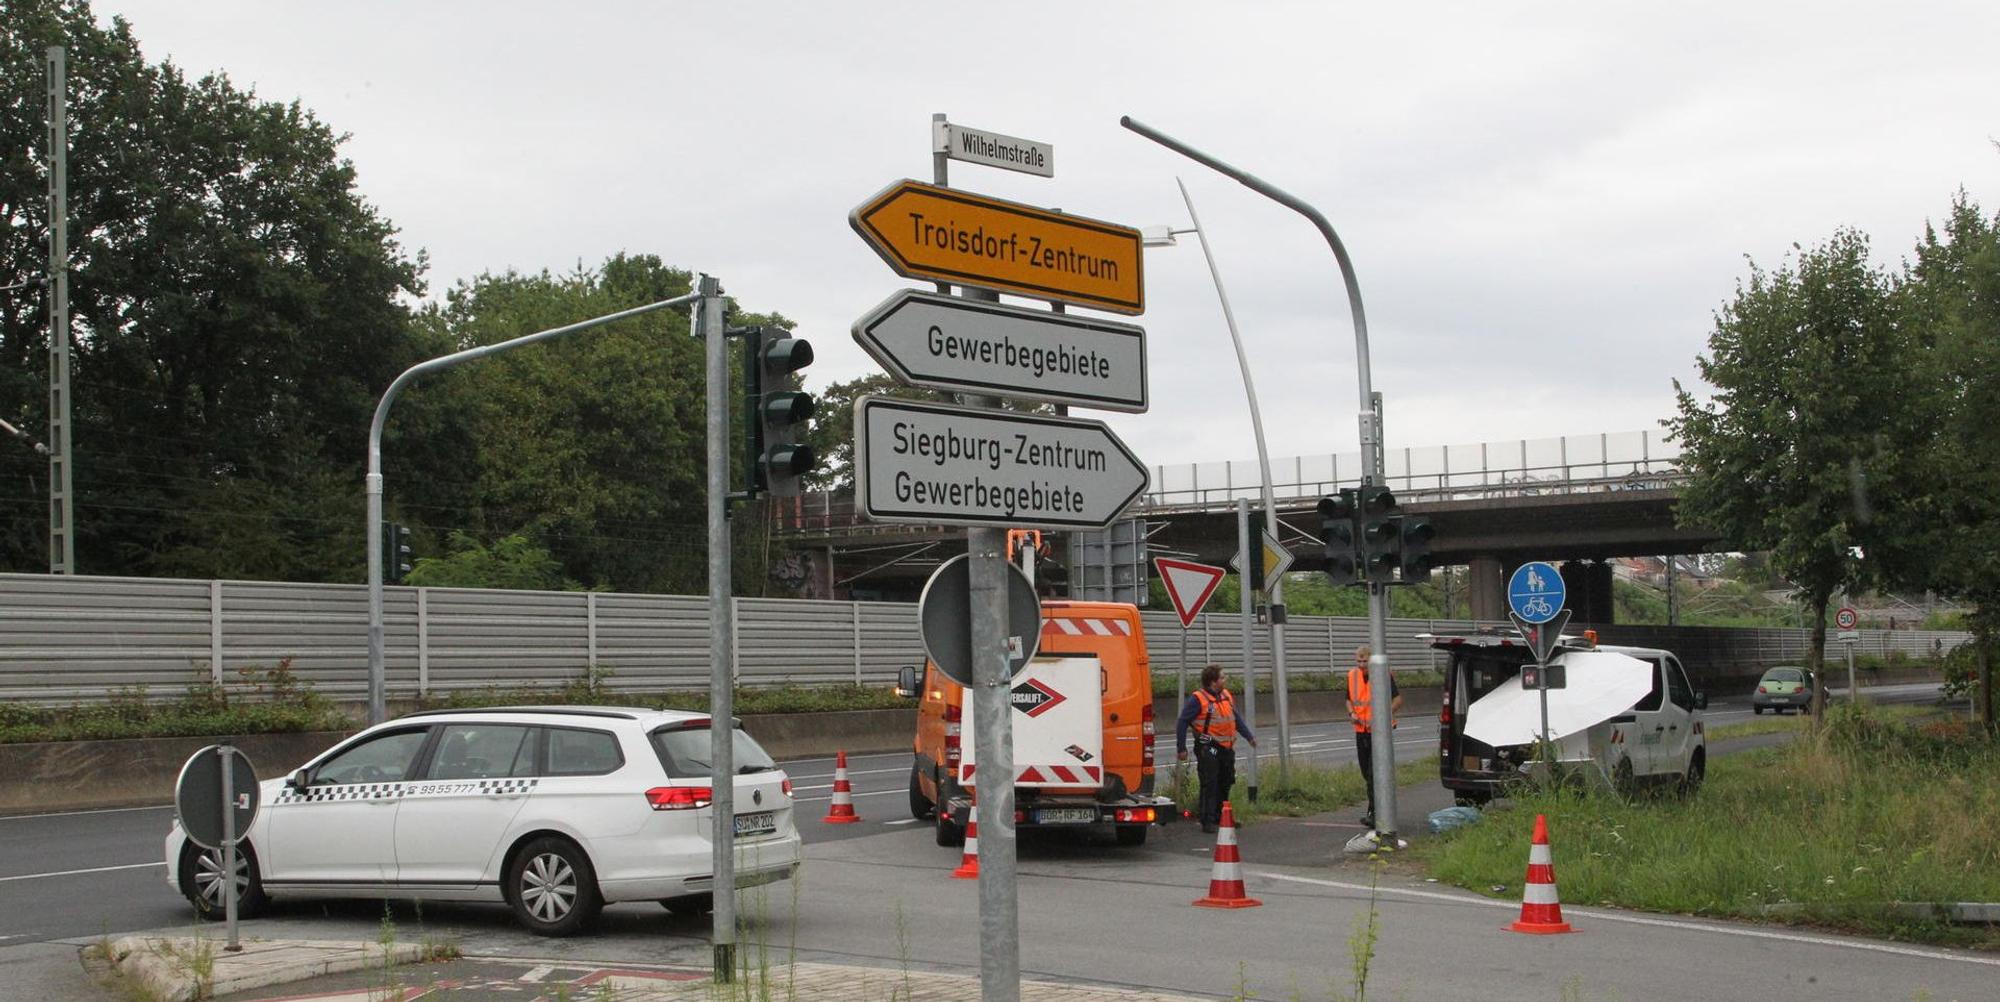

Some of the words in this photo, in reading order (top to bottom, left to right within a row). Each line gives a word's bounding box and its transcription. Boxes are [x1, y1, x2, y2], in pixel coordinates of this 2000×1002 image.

[962, 132, 1044, 168] Wilhelmstraße
[909, 213, 1118, 281] Troisdorf-Zentrum
[928, 325, 1110, 378] Gewerbegebiete
[893, 422, 1106, 472] Siegburg-Zentrum
[895, 471, 1084, 517] Gewerbegebiete
[1840, 614, 1853, 624] 50
